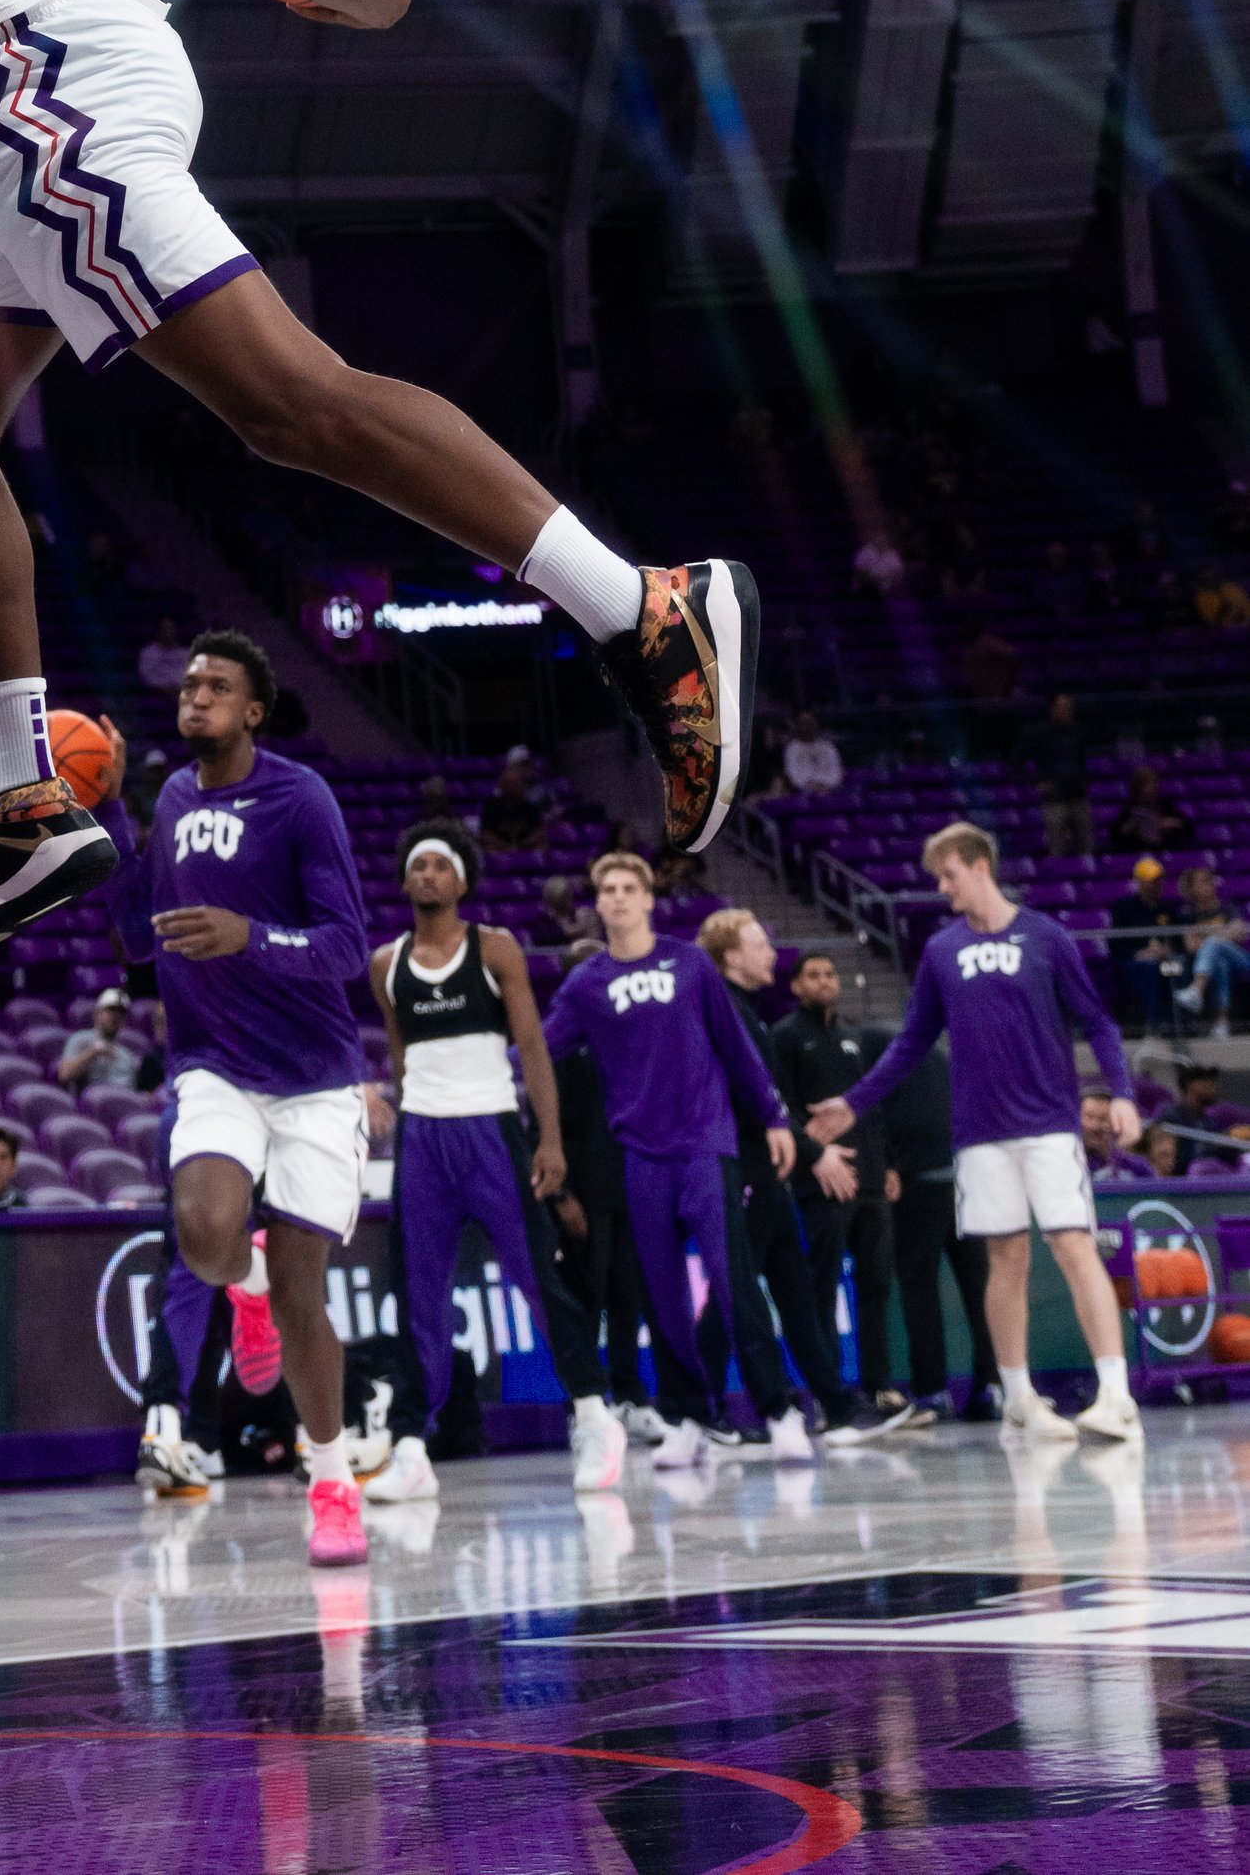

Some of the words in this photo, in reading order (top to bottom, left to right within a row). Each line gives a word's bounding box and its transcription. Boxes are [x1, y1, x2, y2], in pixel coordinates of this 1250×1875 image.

[174, 808, 245, 864] TCU
[956, 942, 1023, 980] TCU
[607, 970, 676, 1015] TCU
